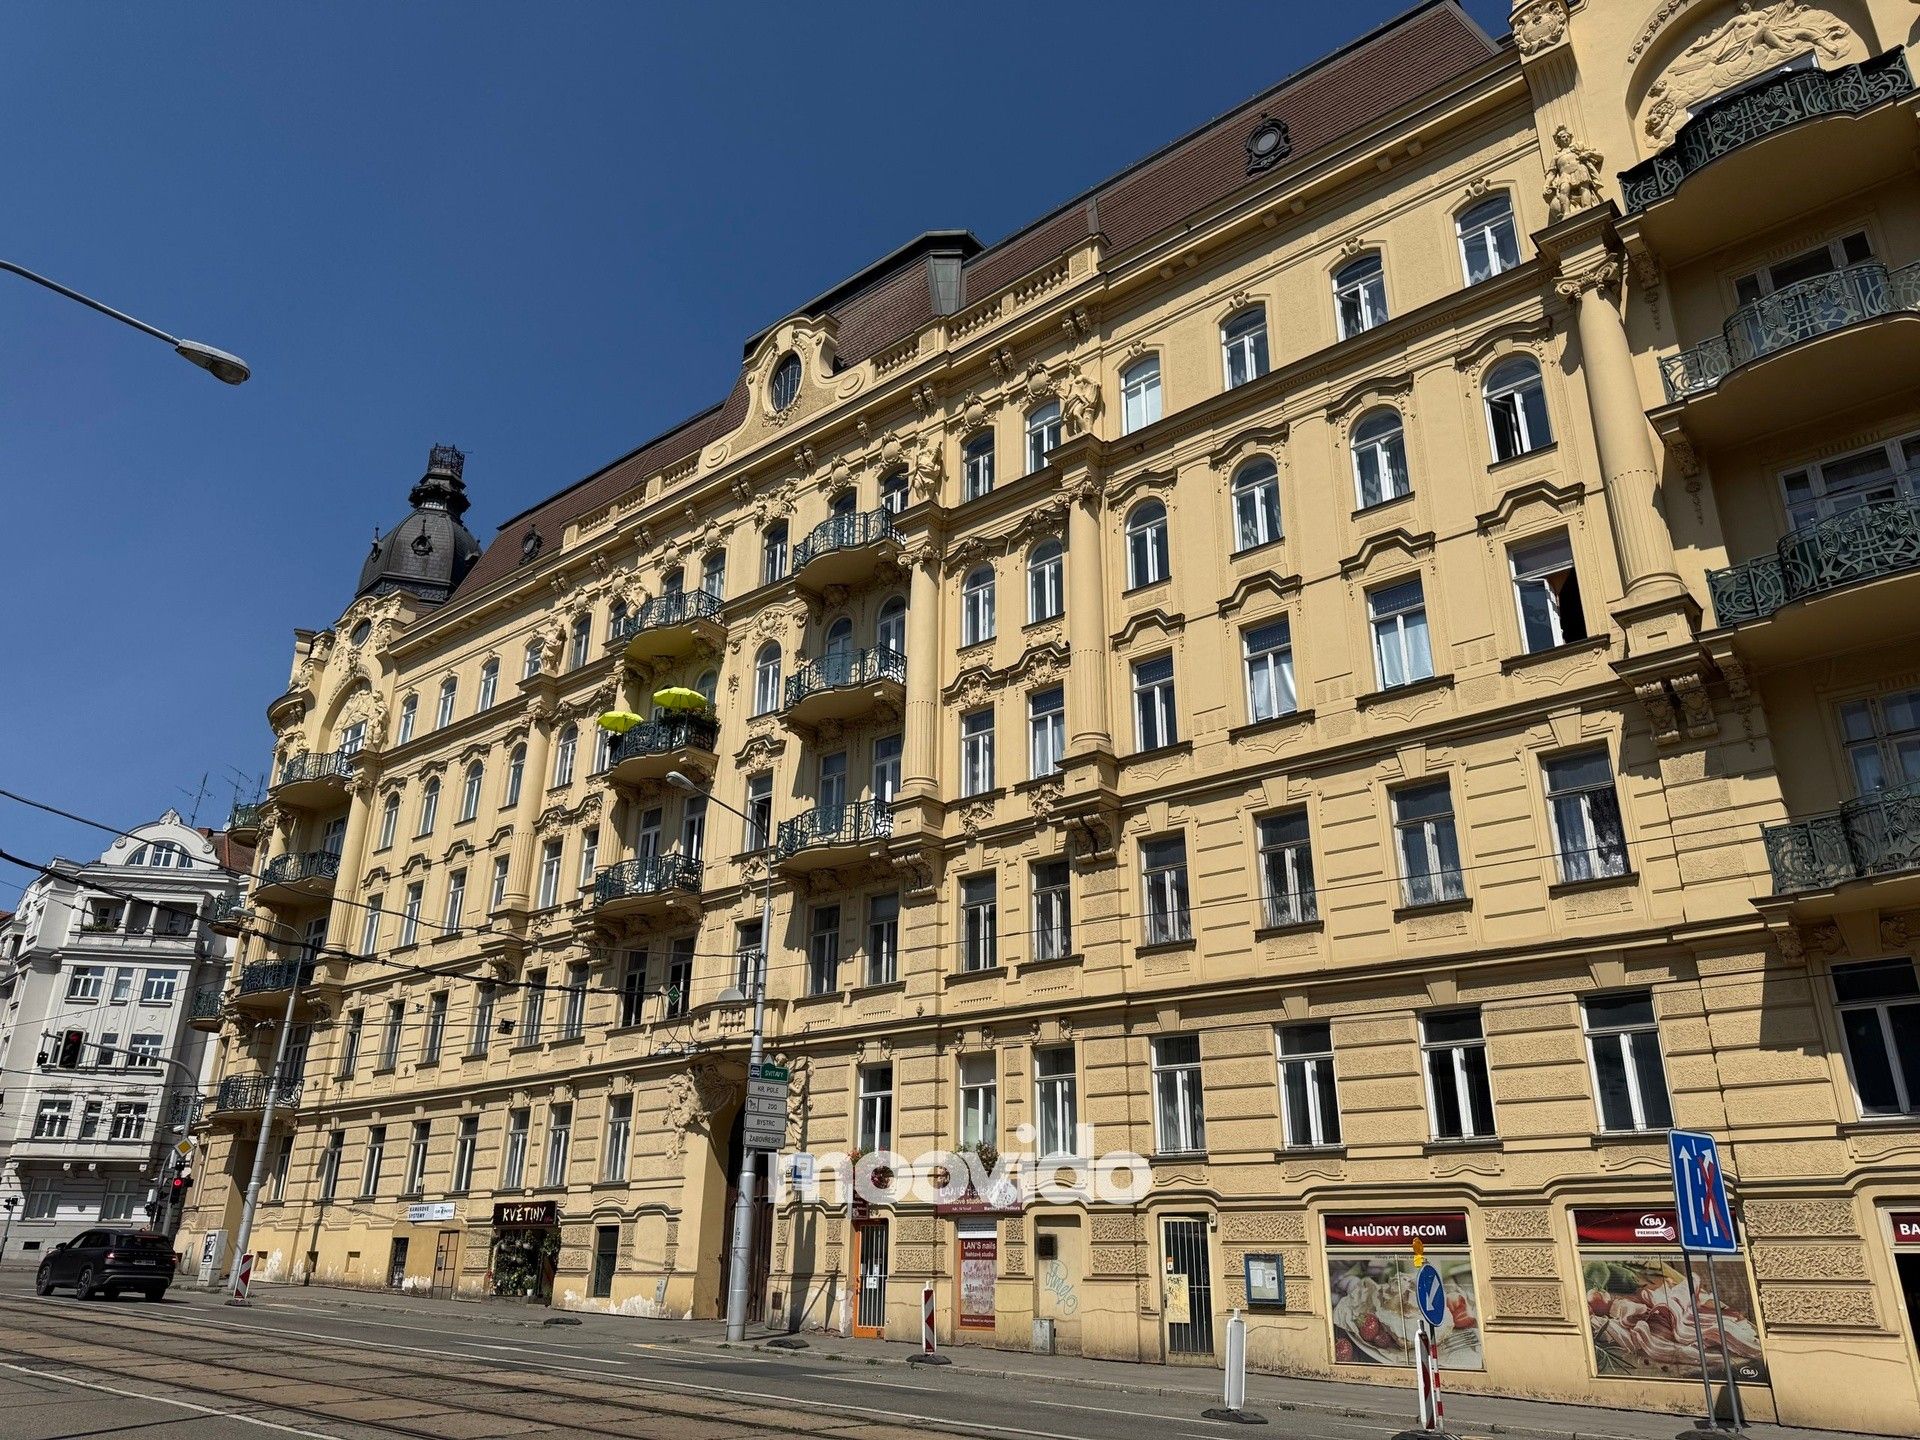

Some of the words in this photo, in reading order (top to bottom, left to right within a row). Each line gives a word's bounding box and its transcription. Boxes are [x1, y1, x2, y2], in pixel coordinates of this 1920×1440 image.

[764, 1069, 784, 1078] SVITAVY
[766, 1086, 779, 1094] POLE
[767, 1103, 778, 1111] ZOO
[756, 1118, 776, 1127] BYSTRC
[503, 1204, 547, 1222] KVĚTINY
[1344, 1223, 1400, 1237] LAHŮDKY
[1402, 1225, 1447, 1236] BACOM
[963, 1241, 981, 1250] LAN'S
[981, 1241, 996, 1250] nails
